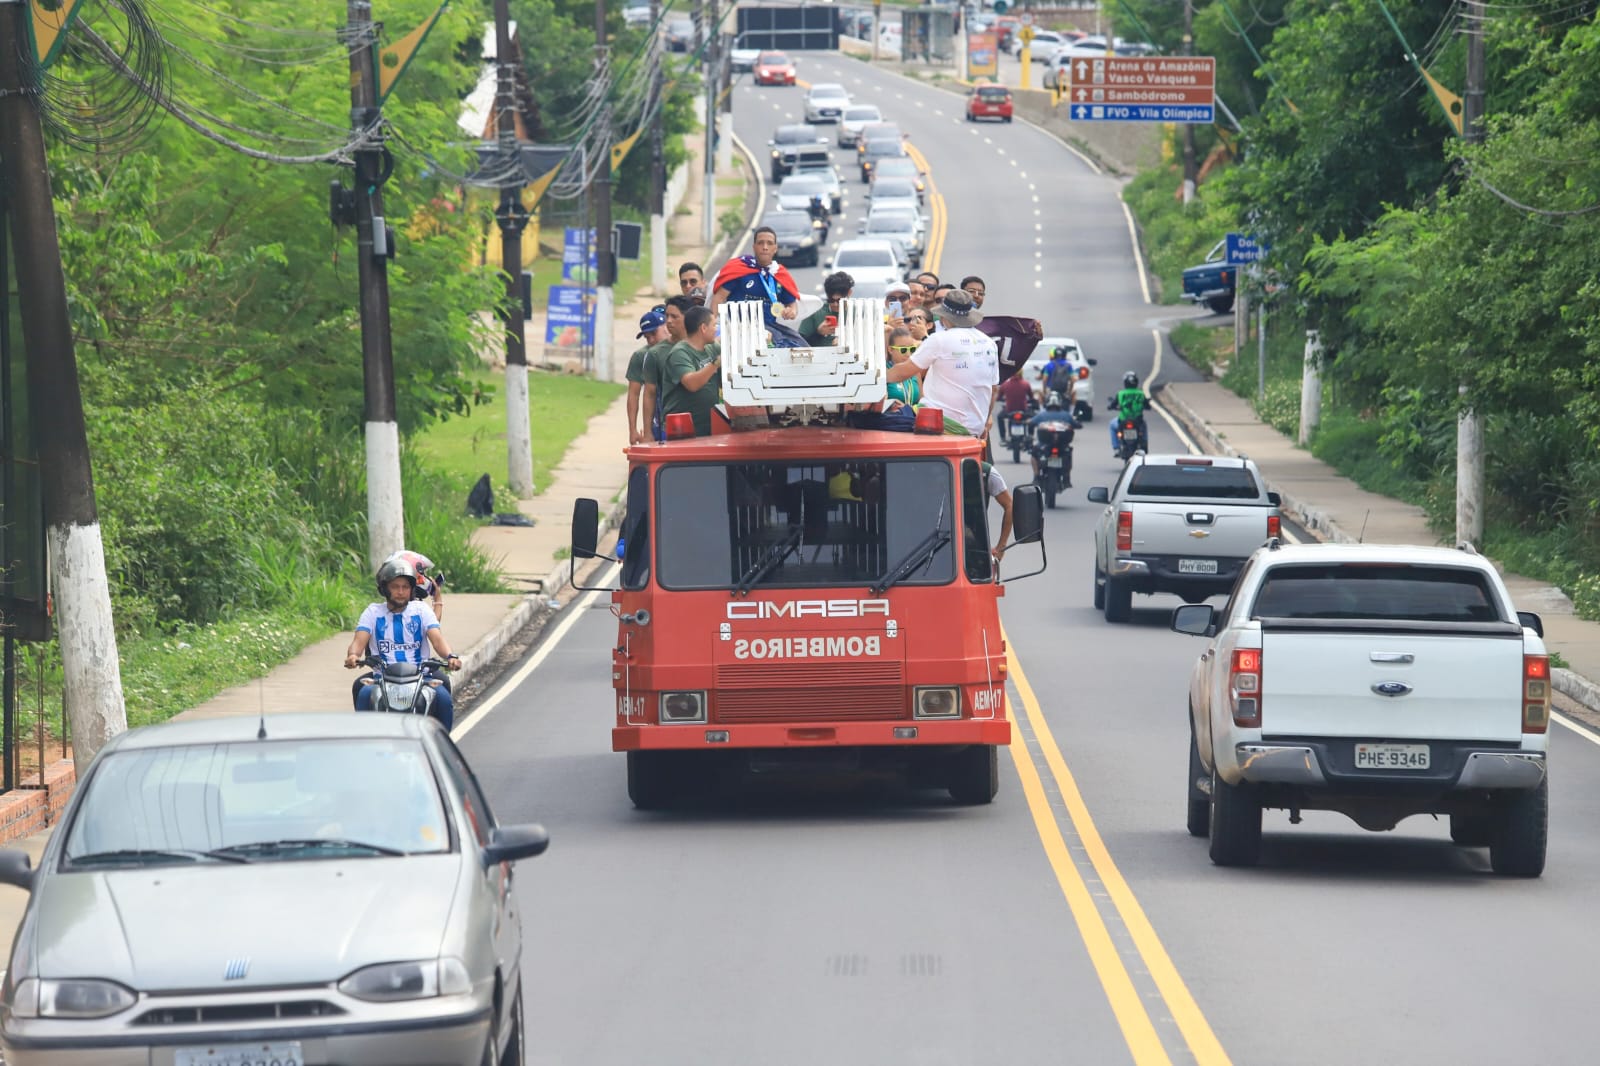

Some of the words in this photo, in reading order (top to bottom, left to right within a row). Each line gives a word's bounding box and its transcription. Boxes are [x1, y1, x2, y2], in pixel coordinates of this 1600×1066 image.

[1109, 61, 1140, 72] Arena
[1143, 61, 1156, 72] da
[1159, 61, 1211, 72] Amazônia
[1109, 73, 1144, 84] Vasco
[1147, 73, 1197, 86] Vasques
[1108, 89, 1186, 101] Sambódromo
[1107, 107, 1130, 118] FVO
[1139, 107, 1160, 118] Vila
[1162, 107, 1210, 120] Olímpica
[726, 599, 890, 619] CIMASA
